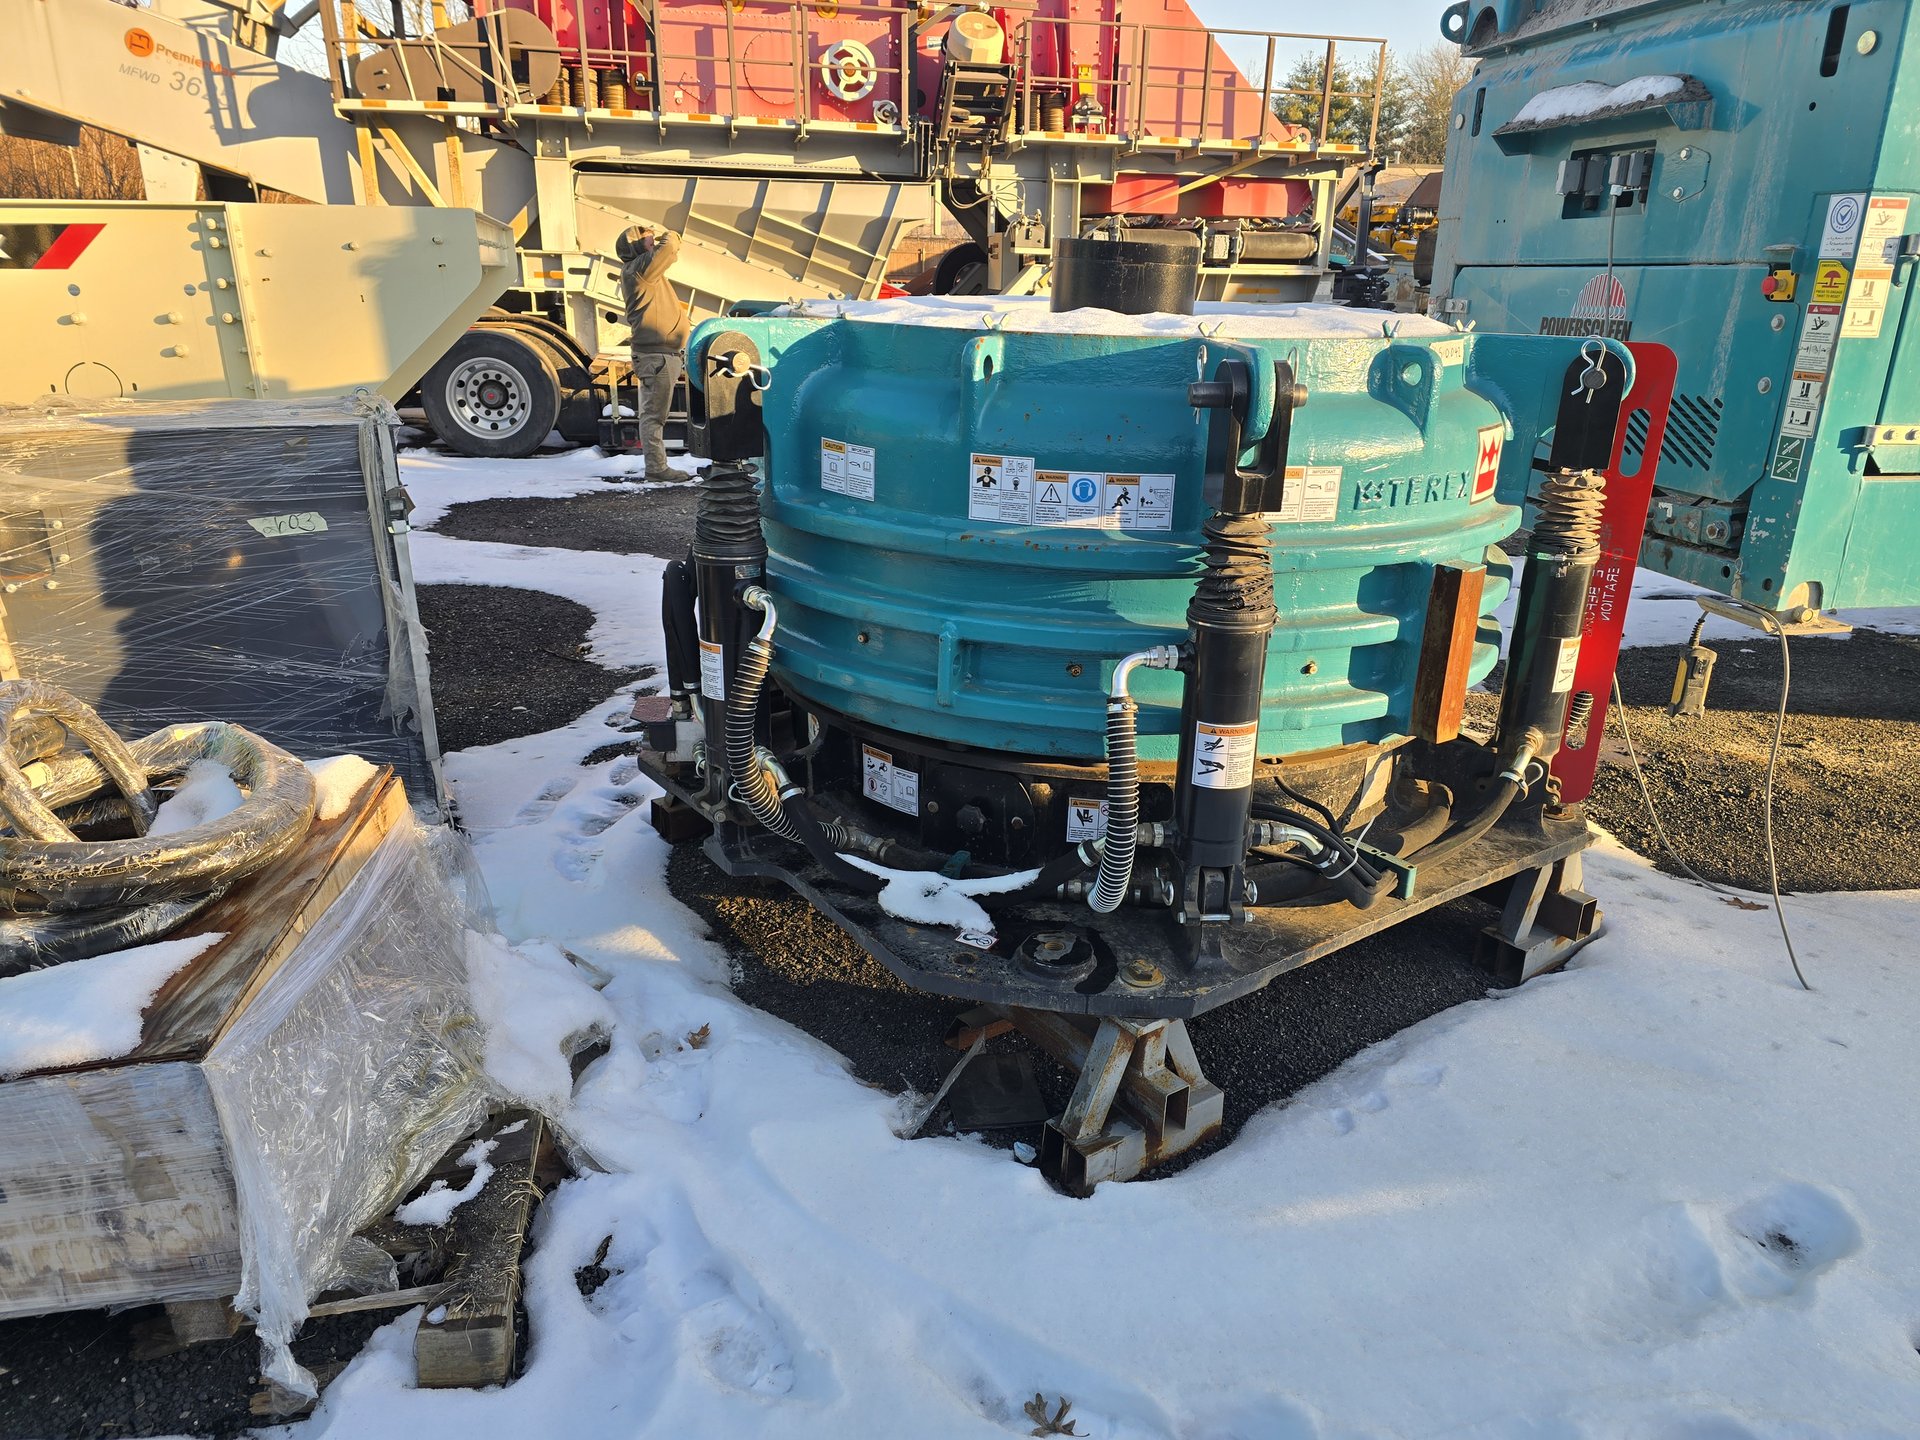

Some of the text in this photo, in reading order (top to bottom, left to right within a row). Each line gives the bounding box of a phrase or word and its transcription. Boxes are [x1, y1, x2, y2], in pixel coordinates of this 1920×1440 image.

[119, 64, 160, 84] MFWD
[1388, 470, 1470, 507] TEREX
[1219, 727, 1249, 735] WARNING
